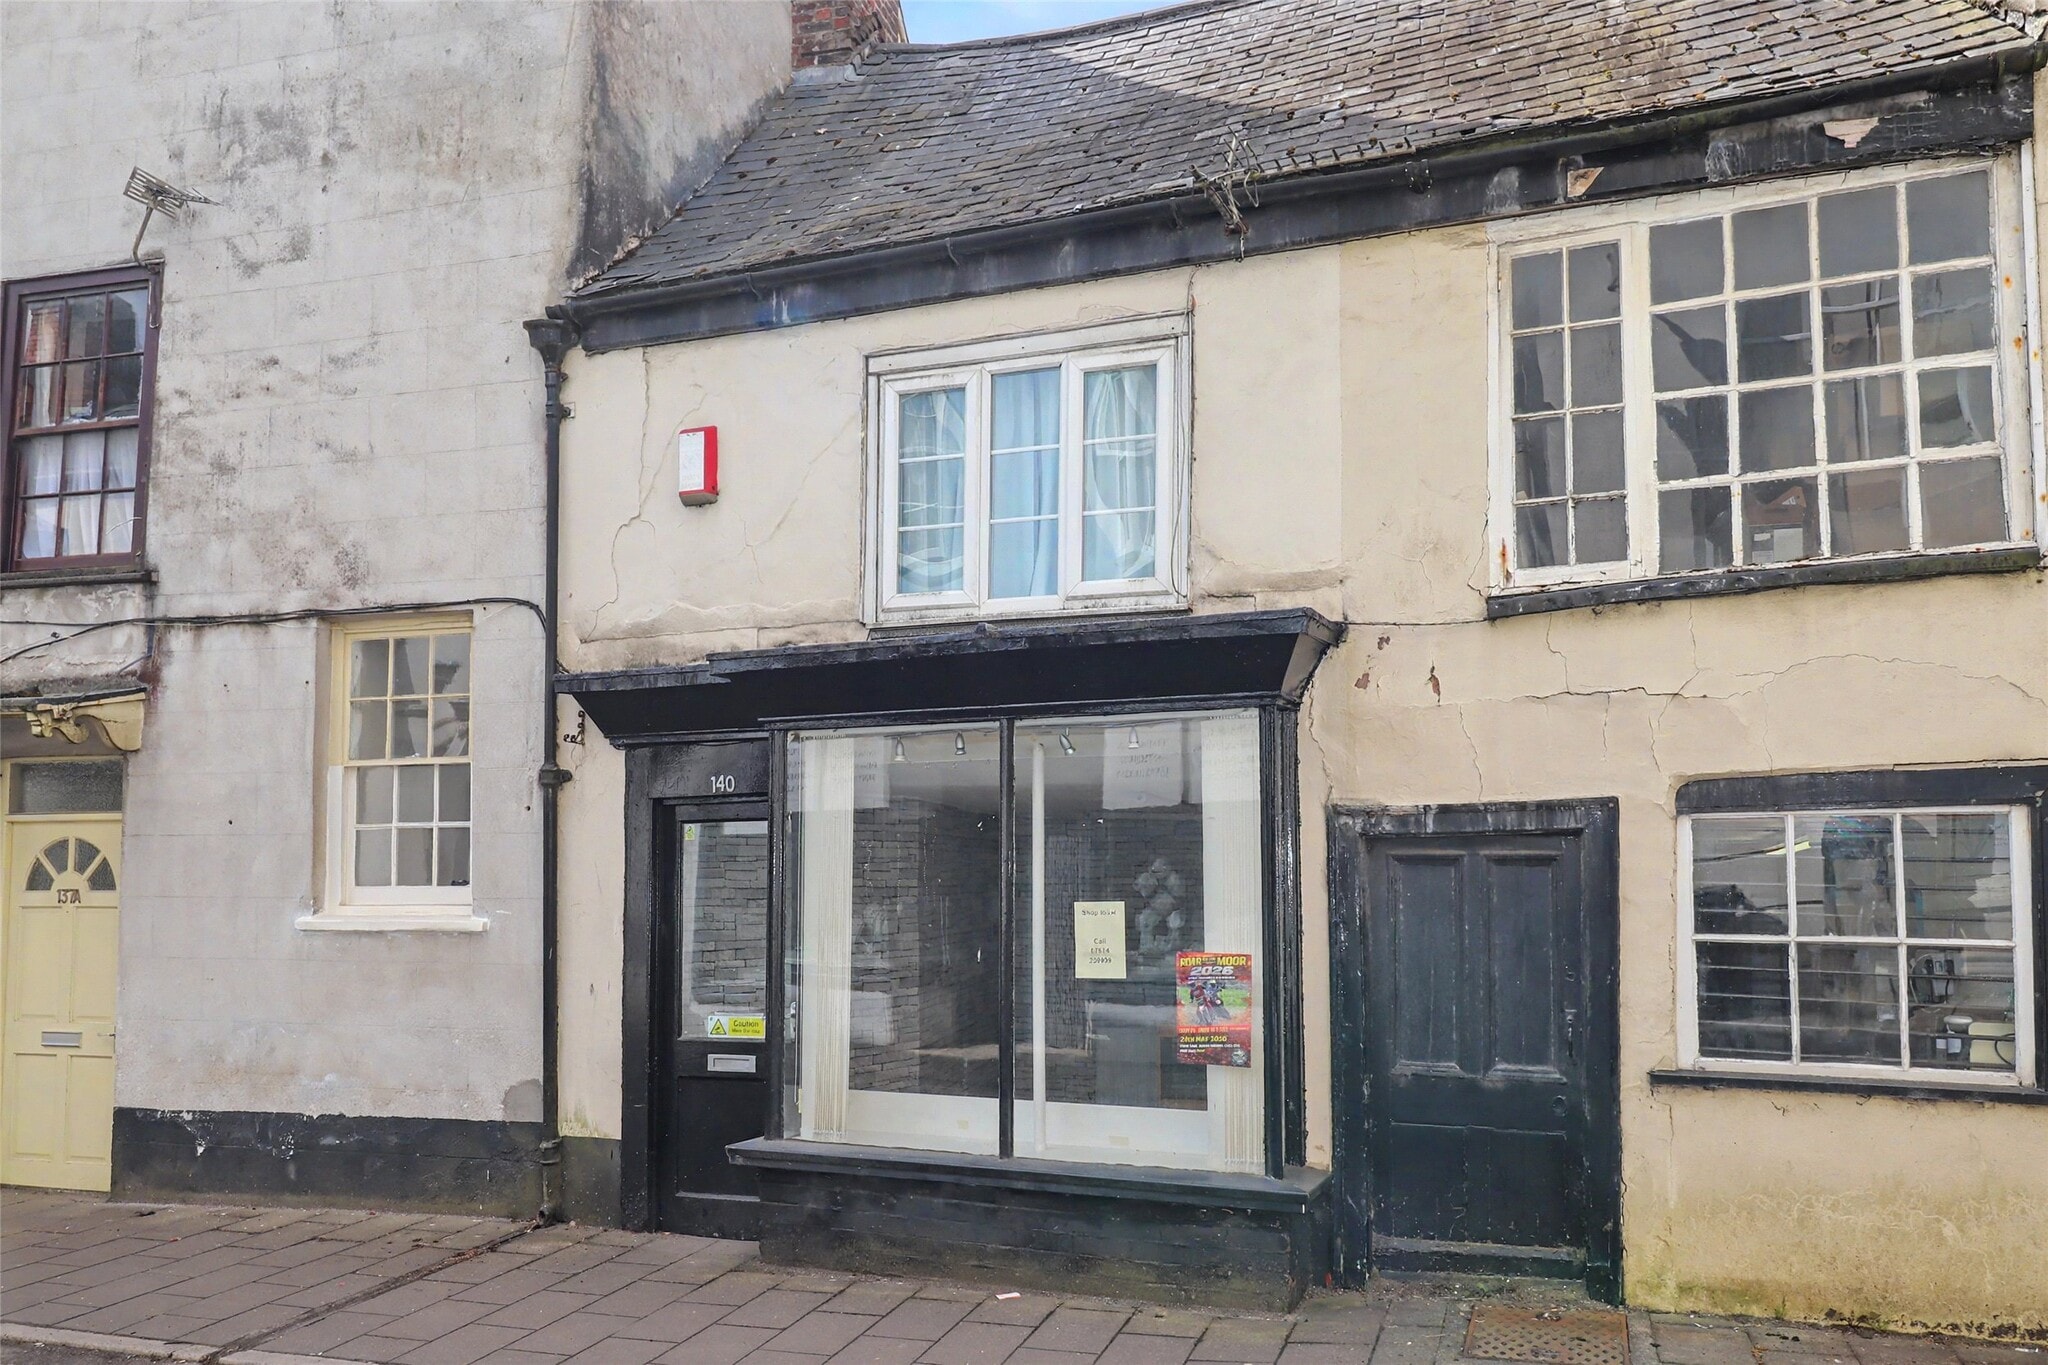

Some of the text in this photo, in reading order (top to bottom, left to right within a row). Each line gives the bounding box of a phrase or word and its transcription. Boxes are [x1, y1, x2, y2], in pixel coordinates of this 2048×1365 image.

[710, 774, 735, 793] 140
[57, 889, 81, 904] 137A
[1180, 957, 1202, 967] ROAR
[1217, 956, 1247, 966] MOOR
[1190, 966, 1234, 976] 2026
